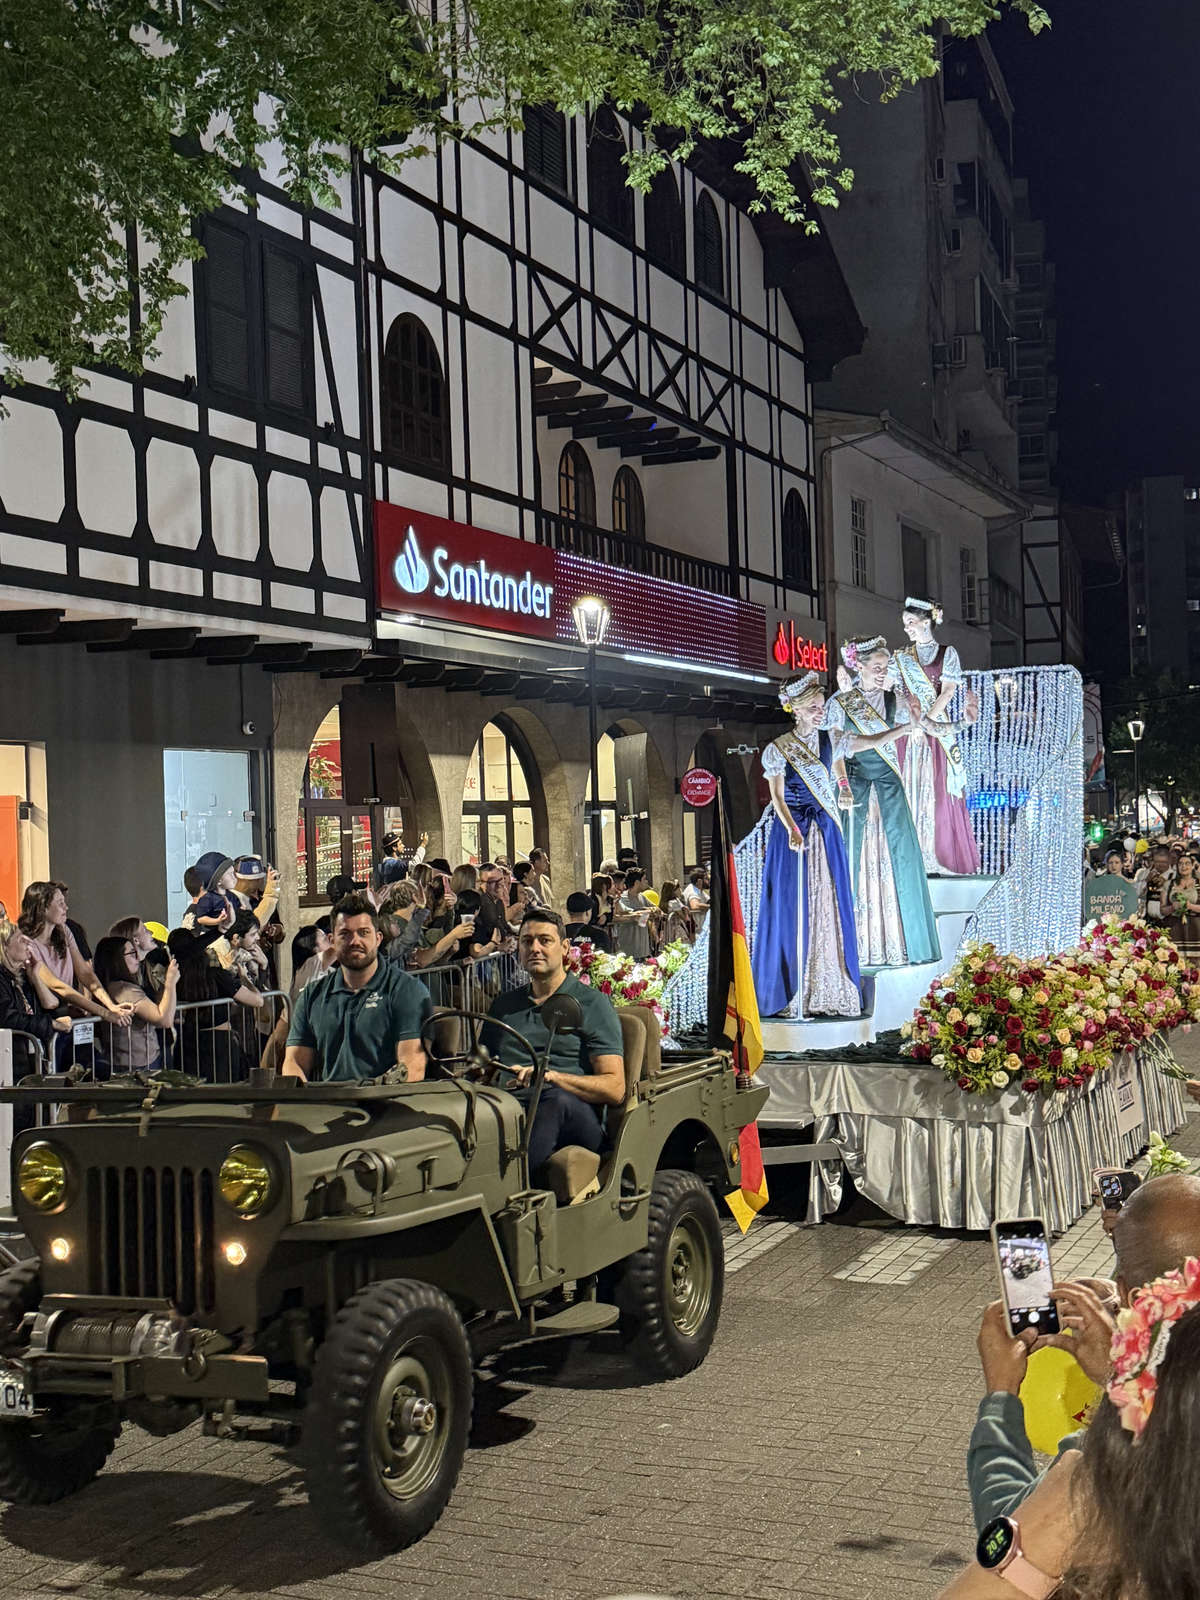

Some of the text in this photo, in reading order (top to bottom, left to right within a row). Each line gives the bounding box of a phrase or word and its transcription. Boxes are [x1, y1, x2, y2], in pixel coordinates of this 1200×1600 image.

[433, 547, 554, 619] Santander
[796, 636, 828, 672] Select
[1090, 895, 1122, 905] BANDA
